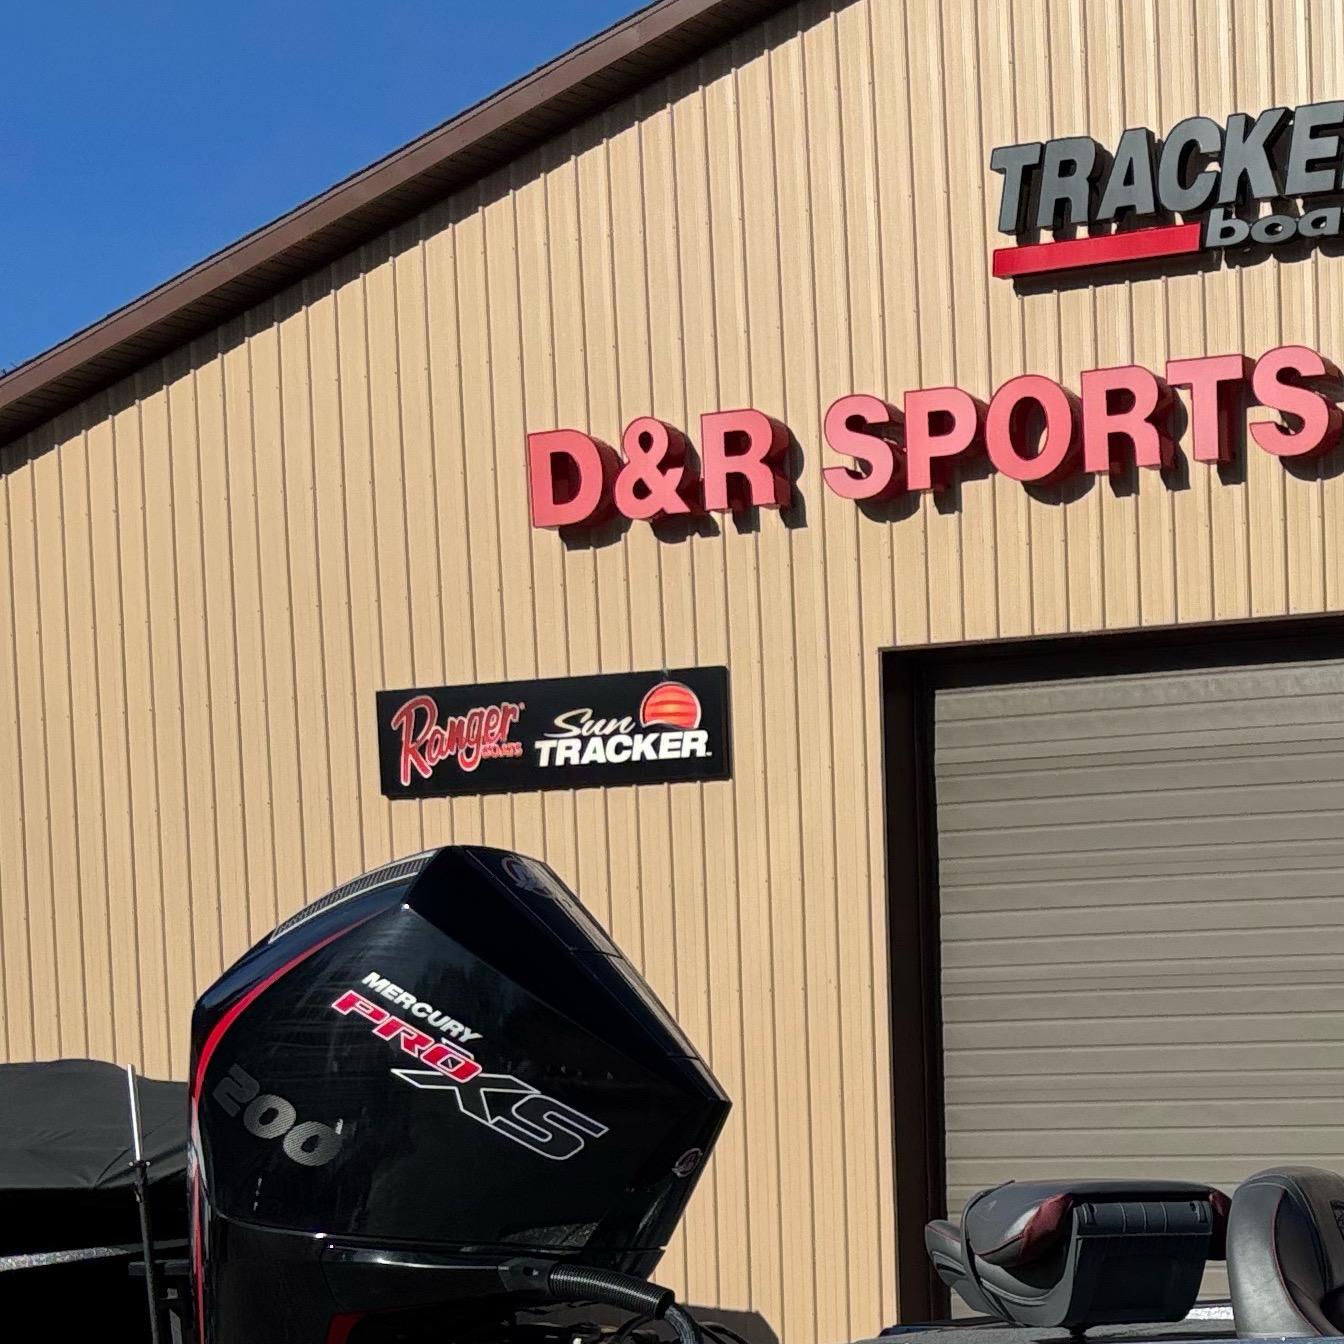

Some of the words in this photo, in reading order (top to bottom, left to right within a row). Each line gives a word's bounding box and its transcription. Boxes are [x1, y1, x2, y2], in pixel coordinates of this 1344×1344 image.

[527, 407, 784, 528] D&R
[822, 345, 1335, 501] SPORTS
[391, 695, 520, 786] Ranger
[534, 729, 709, 767] TRACKER
[544, 708, 636, 738] Sun
[330, 989, 483, 1083] PRO
[362, 971, 483, 1044] MERCURY
[212, 1064, 343, 1167] 200
[390, 1067, 610, 1161] XS
